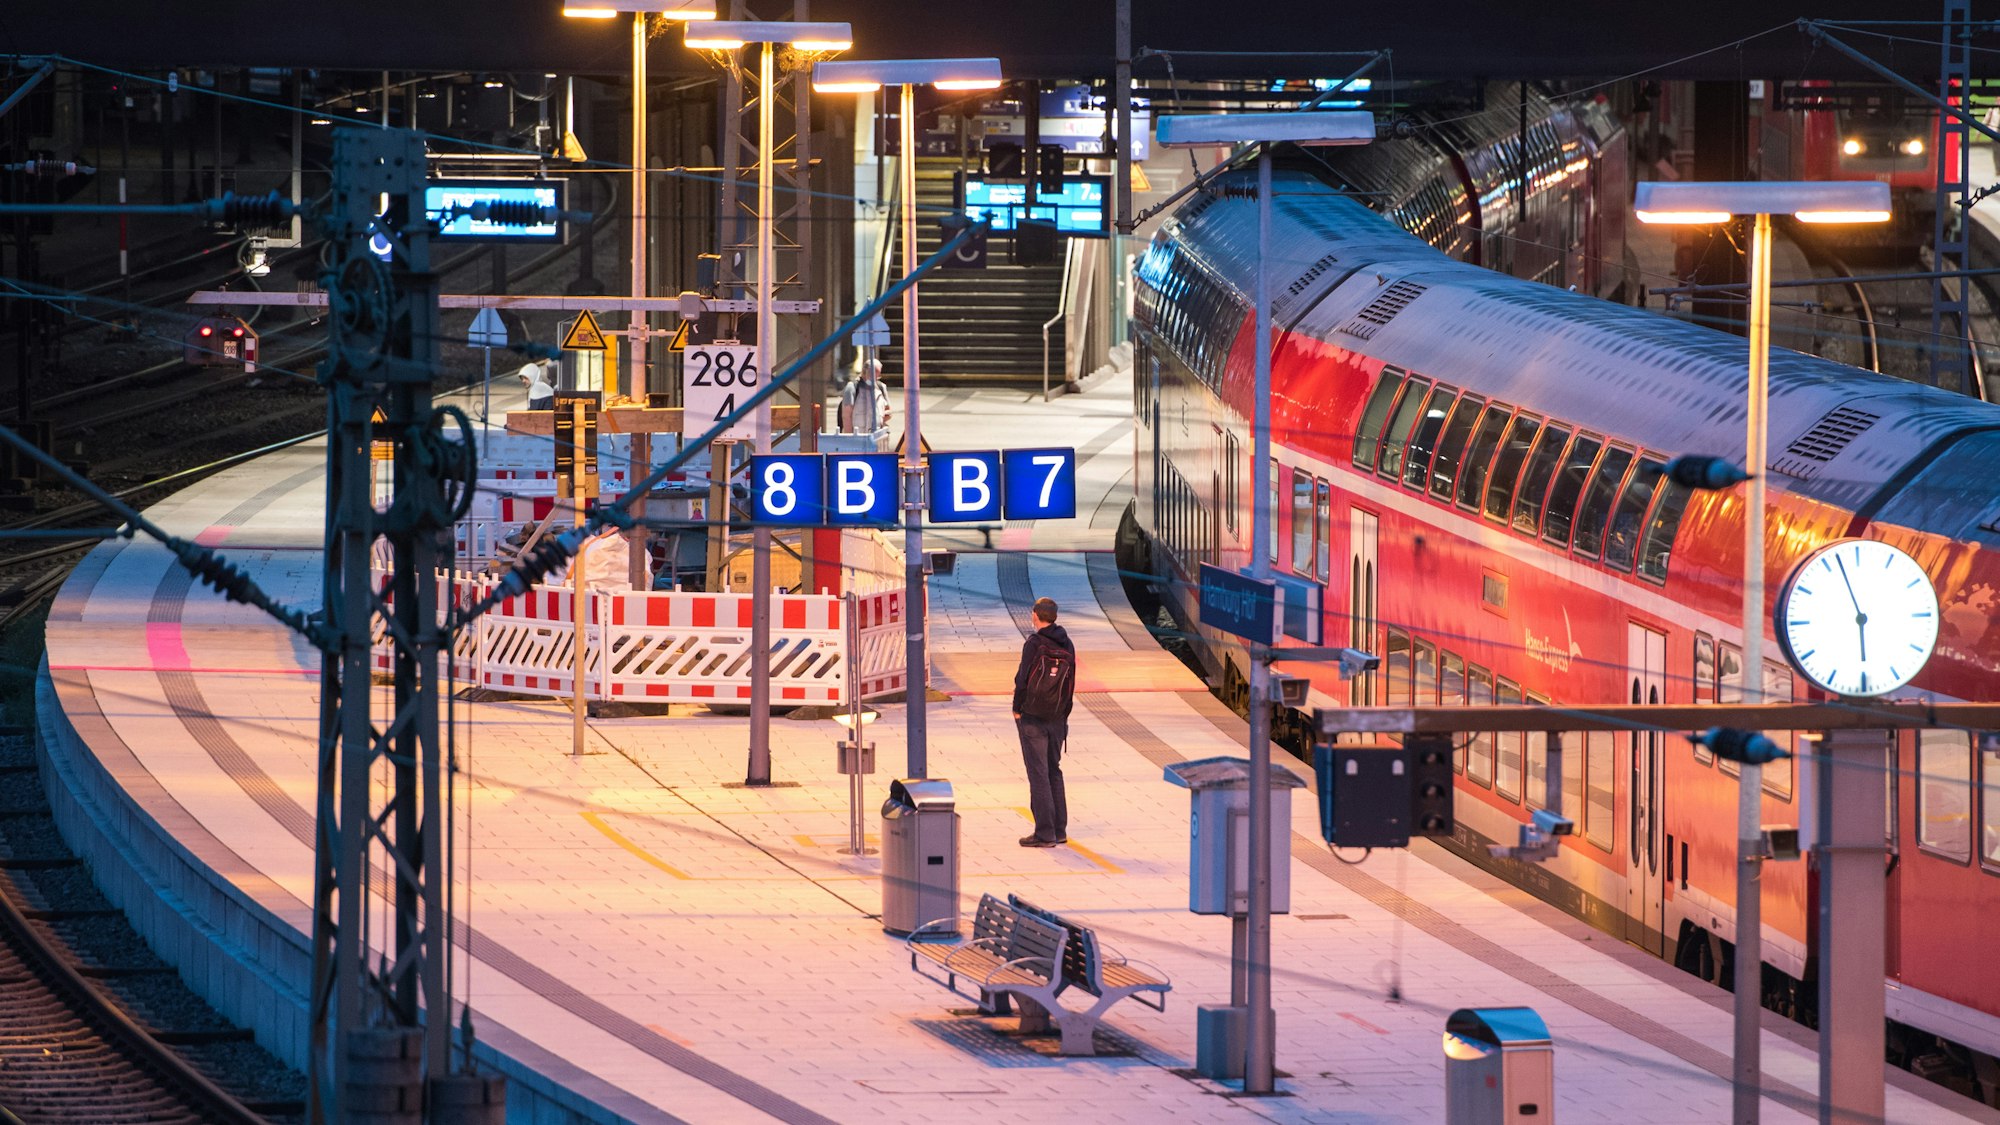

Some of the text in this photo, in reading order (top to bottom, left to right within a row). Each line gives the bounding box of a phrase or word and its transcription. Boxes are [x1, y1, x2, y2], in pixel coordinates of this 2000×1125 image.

[691, 351, 757, 387] 286
[714, 393, 734, 428] 4
[762, 460, 875, 515] 8 B
[952, 456, 1065, 512] B 7
